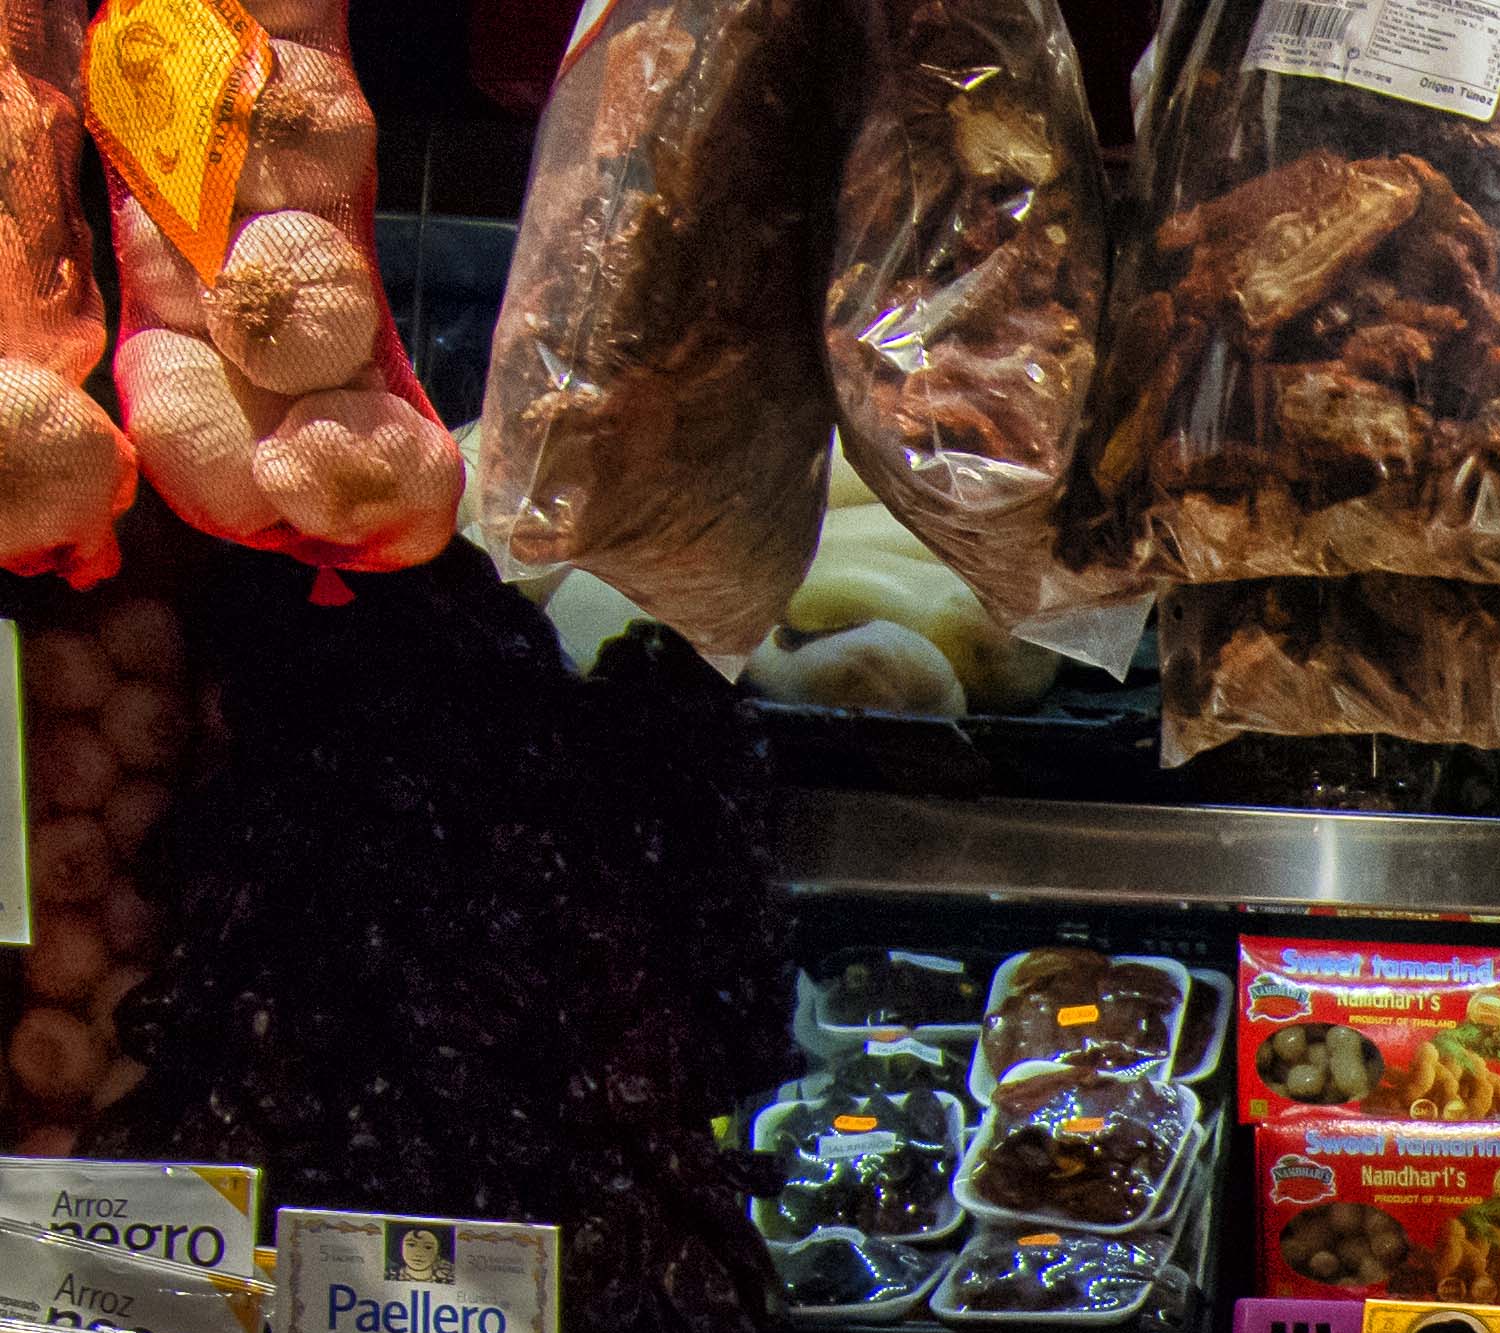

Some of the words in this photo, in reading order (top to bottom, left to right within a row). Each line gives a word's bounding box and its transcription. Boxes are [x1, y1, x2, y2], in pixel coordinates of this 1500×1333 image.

[1282, 949, 1368, 978] Sweet
[1372, 953, 1494, 984] tamarind
[1336, 988, 1441, 1013] Namdhari's
[1305, 1130, 1391, 1157] Sweet
[1361, 1163, 1467, 1190] Namdhari's
[52, 1189, 128, 1220] Arroz
[54, 1272, 134, 1319] Arroz
